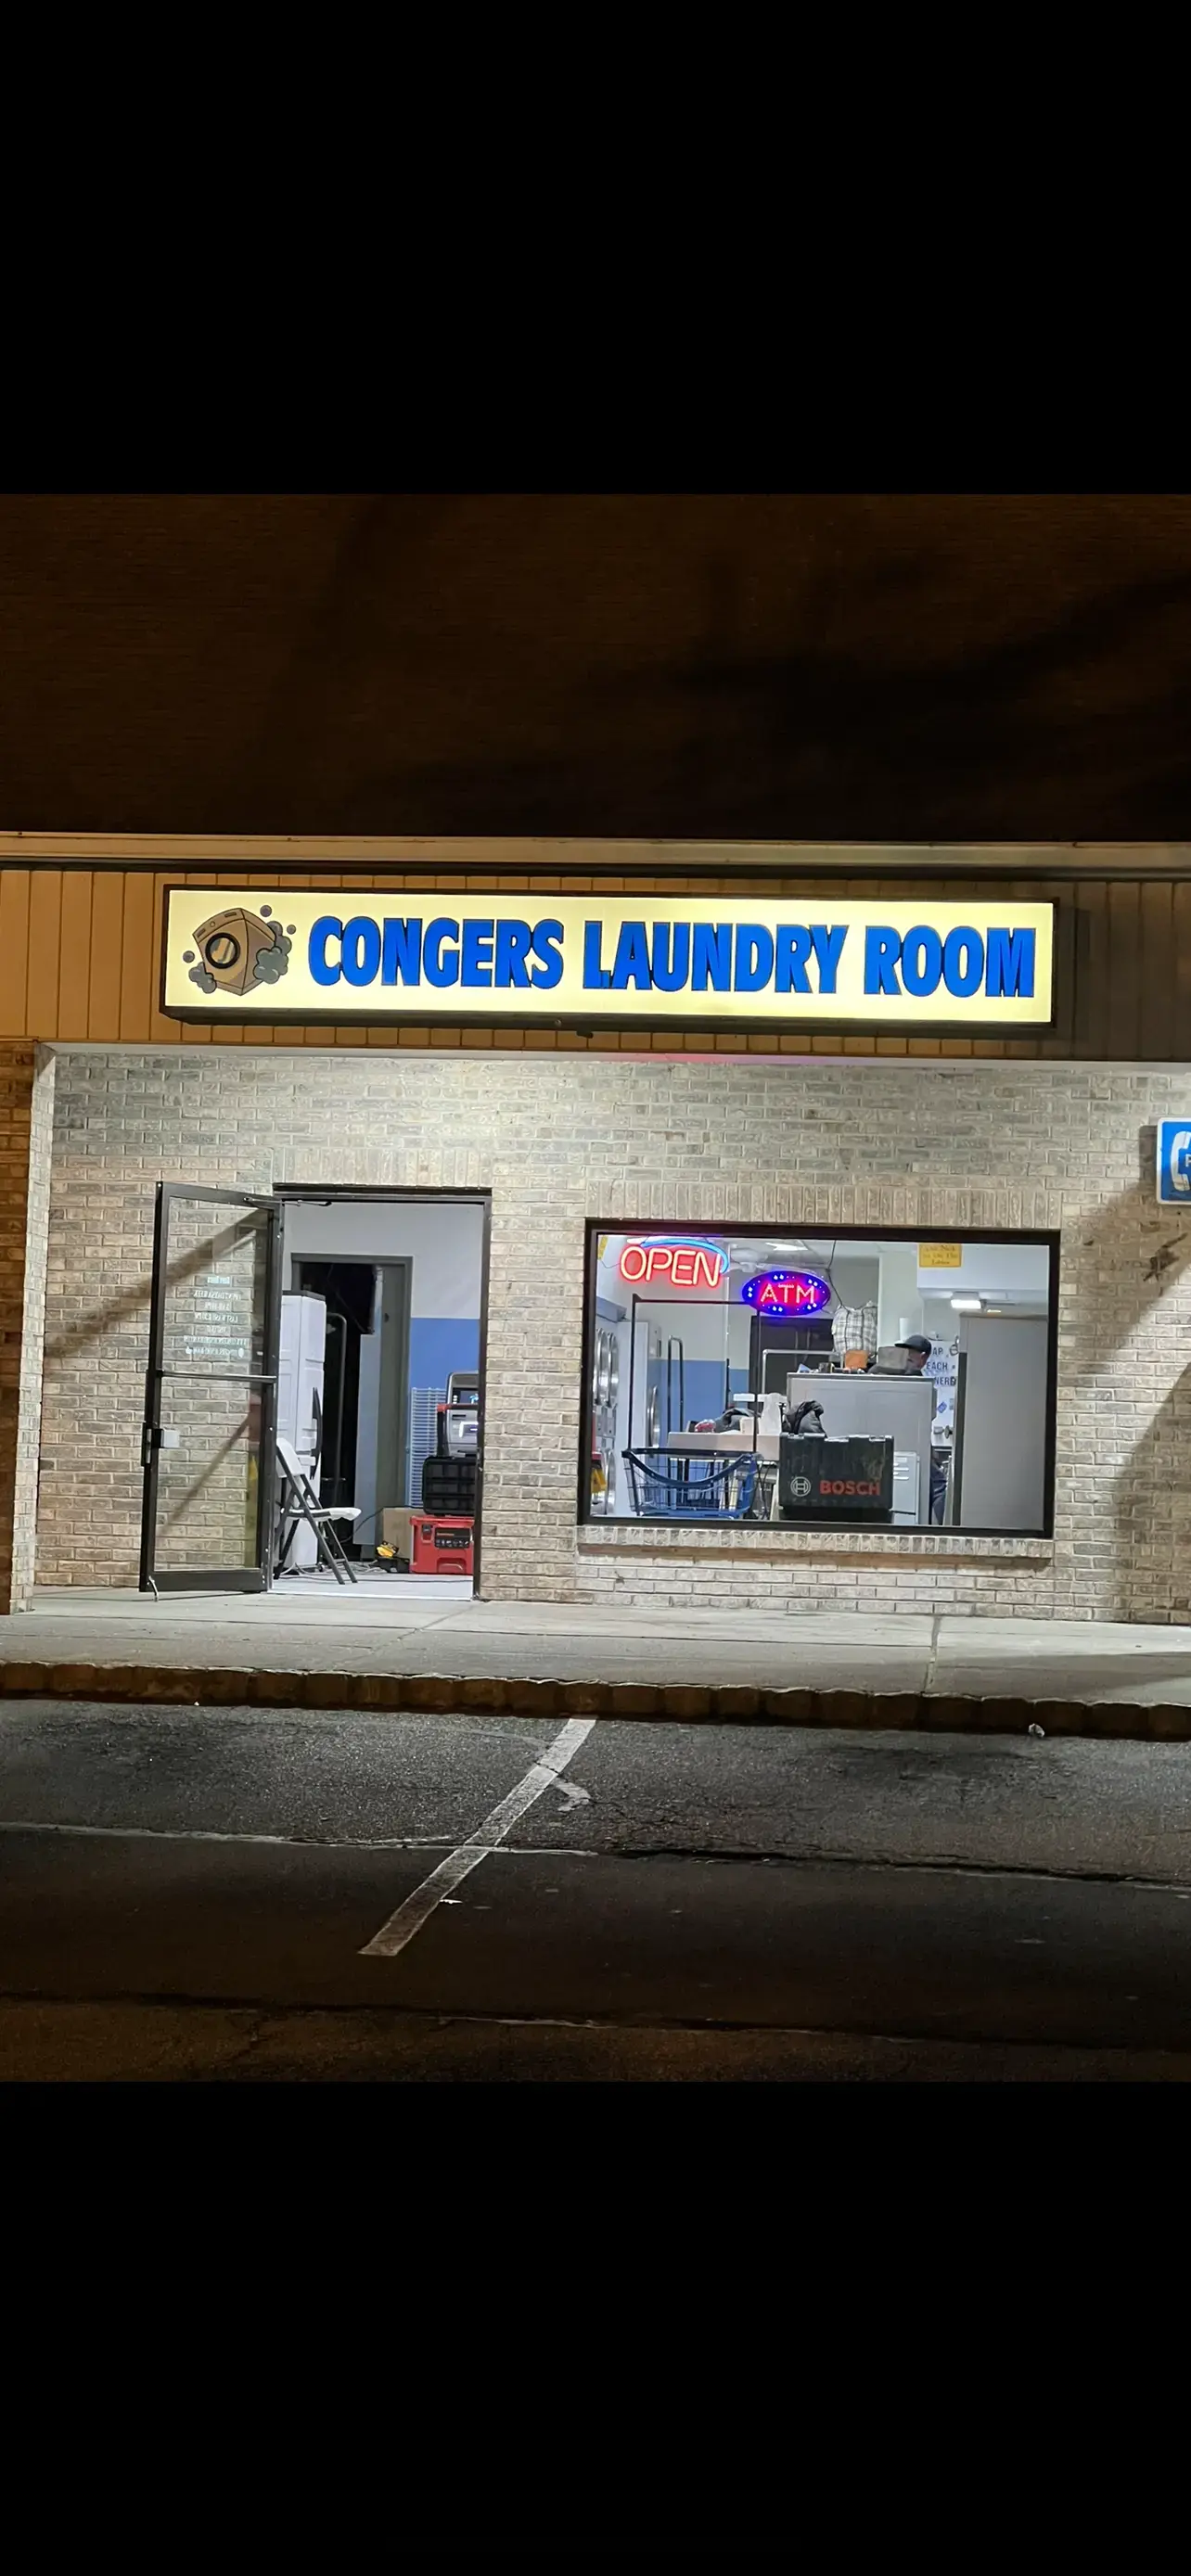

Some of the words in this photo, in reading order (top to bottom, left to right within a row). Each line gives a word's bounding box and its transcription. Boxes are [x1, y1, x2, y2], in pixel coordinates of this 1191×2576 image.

[308, 915, 564, 990] CONGERS
[583, 920, 850, 994] LAUNDRY
[864, 925, 1036, 998] ROOM
[621, 1245, 721, 1287] OPEN
[760, 1283, 814, 1304] ATM
[819, 1480, 881, 1496] BOSCH
